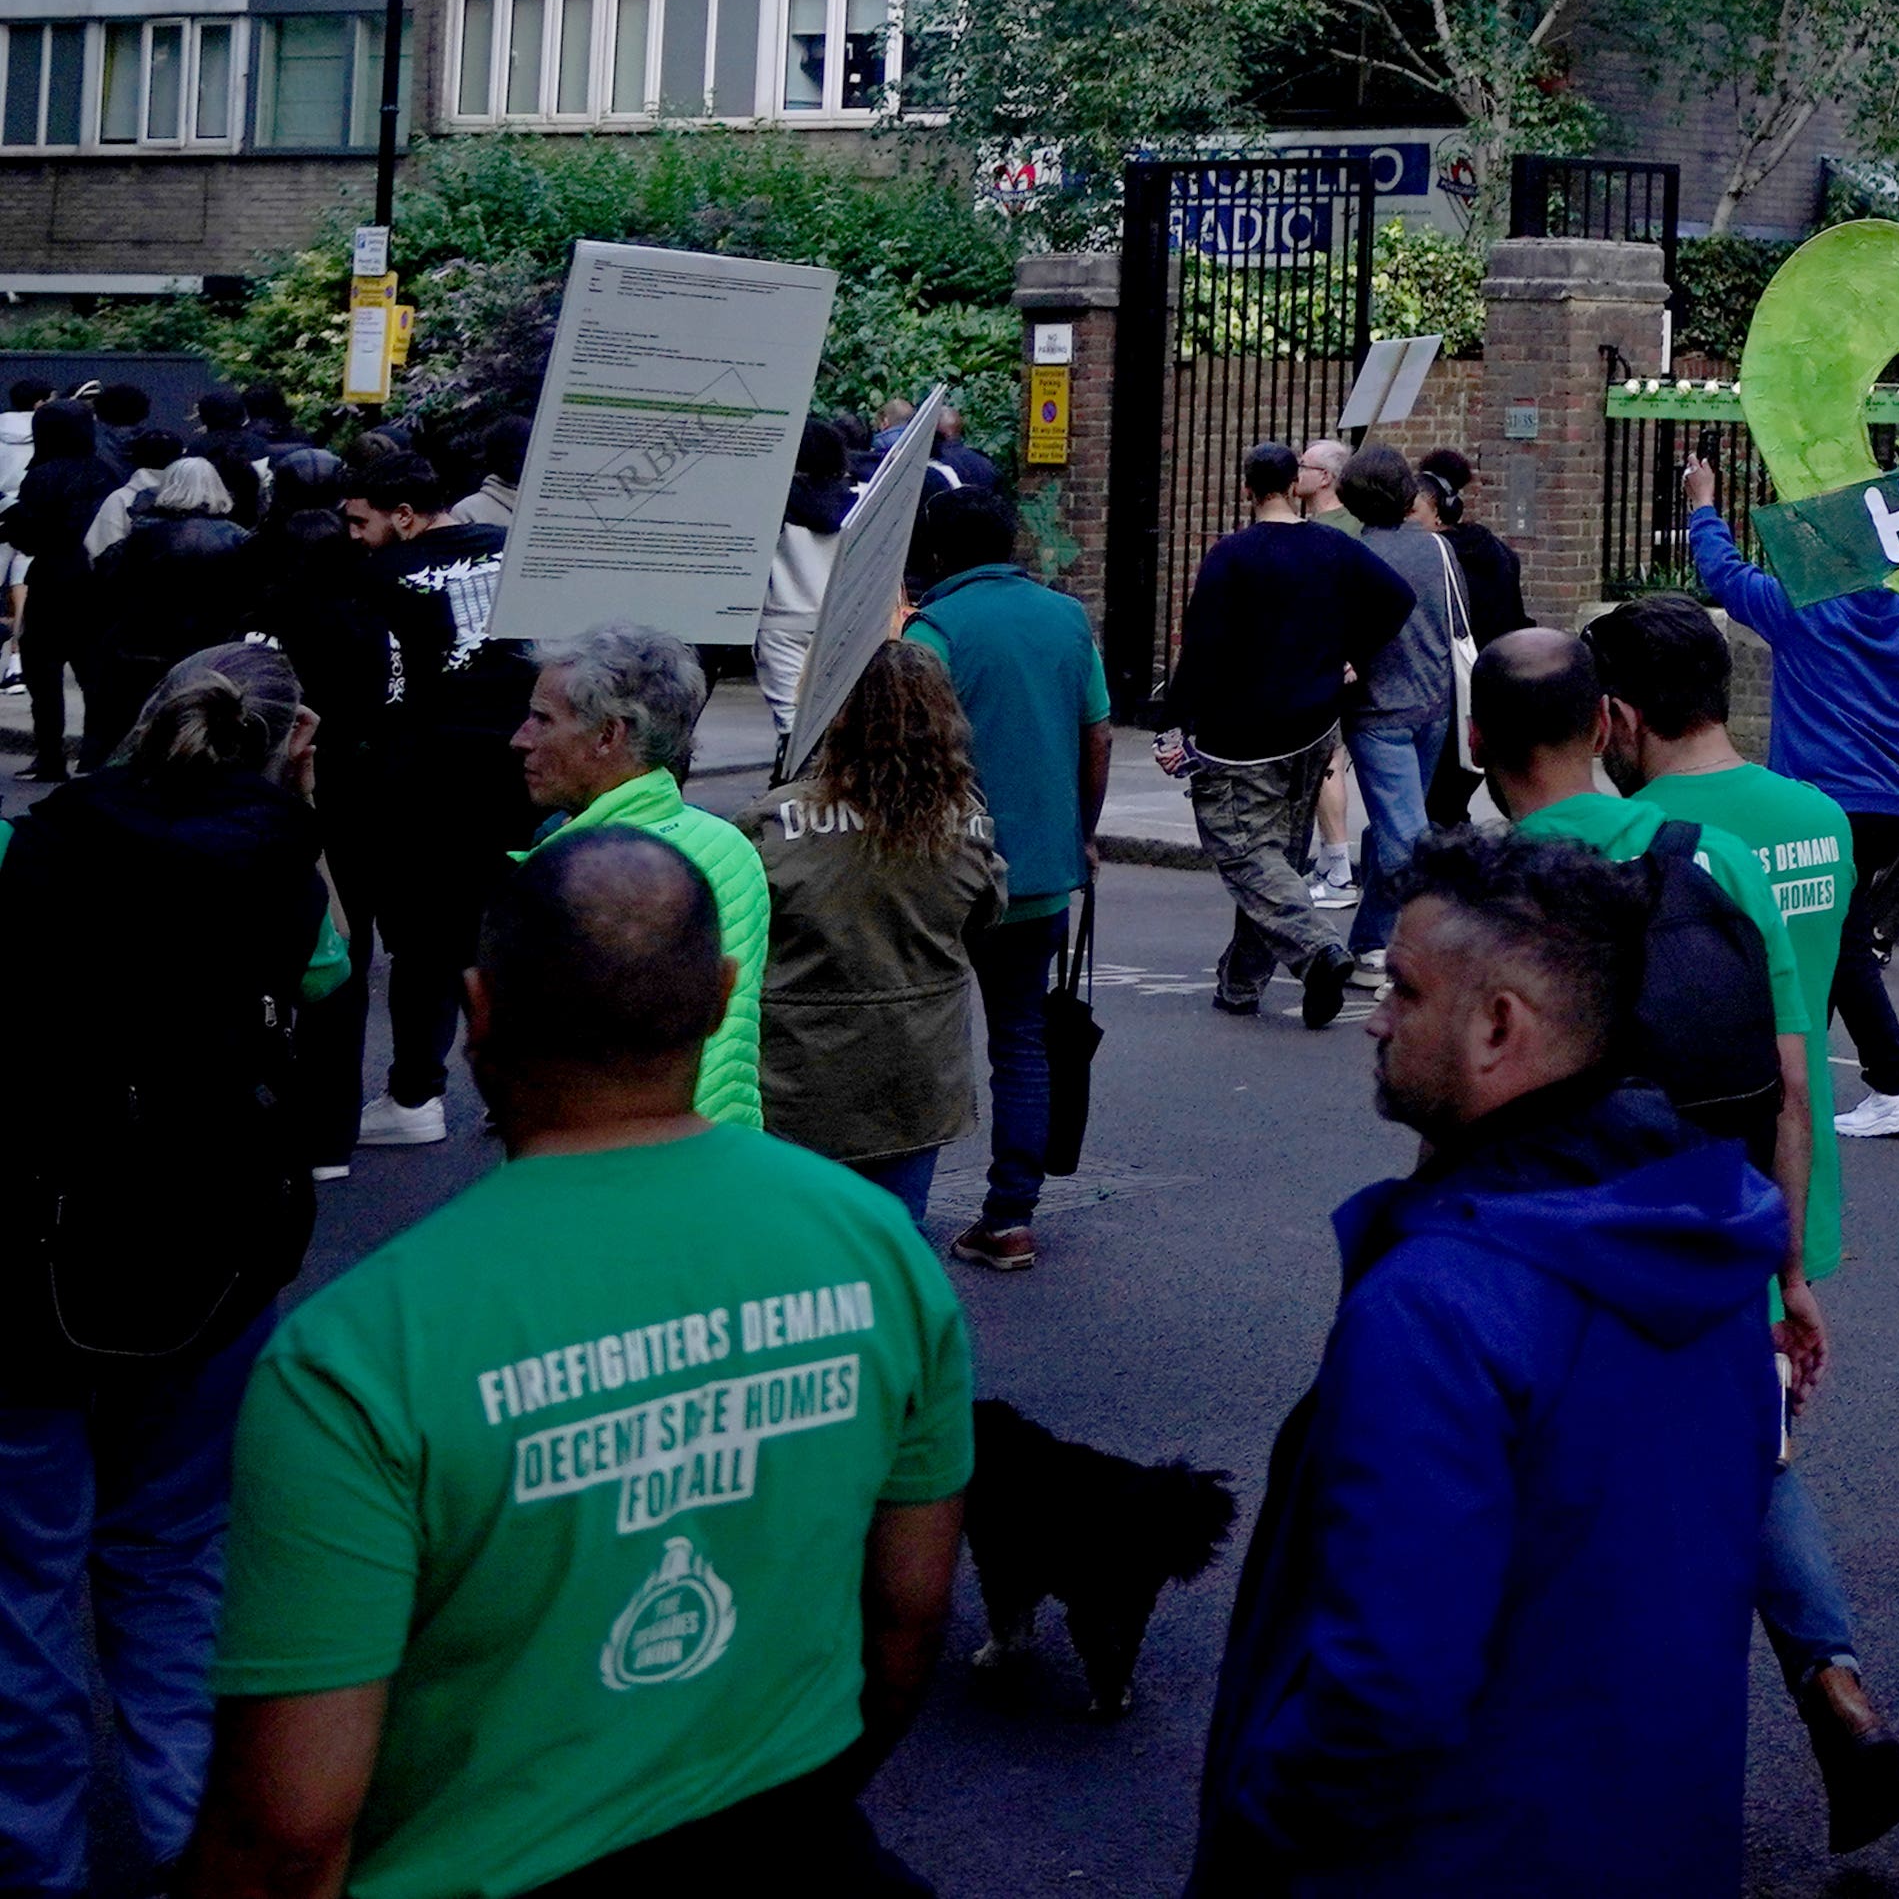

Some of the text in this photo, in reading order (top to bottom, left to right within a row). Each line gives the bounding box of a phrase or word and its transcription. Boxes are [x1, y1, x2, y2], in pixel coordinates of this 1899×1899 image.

[1775, 835, 1840, 871] DEMAND
[1779, 879, 1833, 912] HOMES
[477, 1281, 875, 1426] FIREFIGHTERS DEMAND
[523, 1362, 854, 1491] DECENT SAFE HOMES
[624, 1447, 745, 1525] FOR ALL
